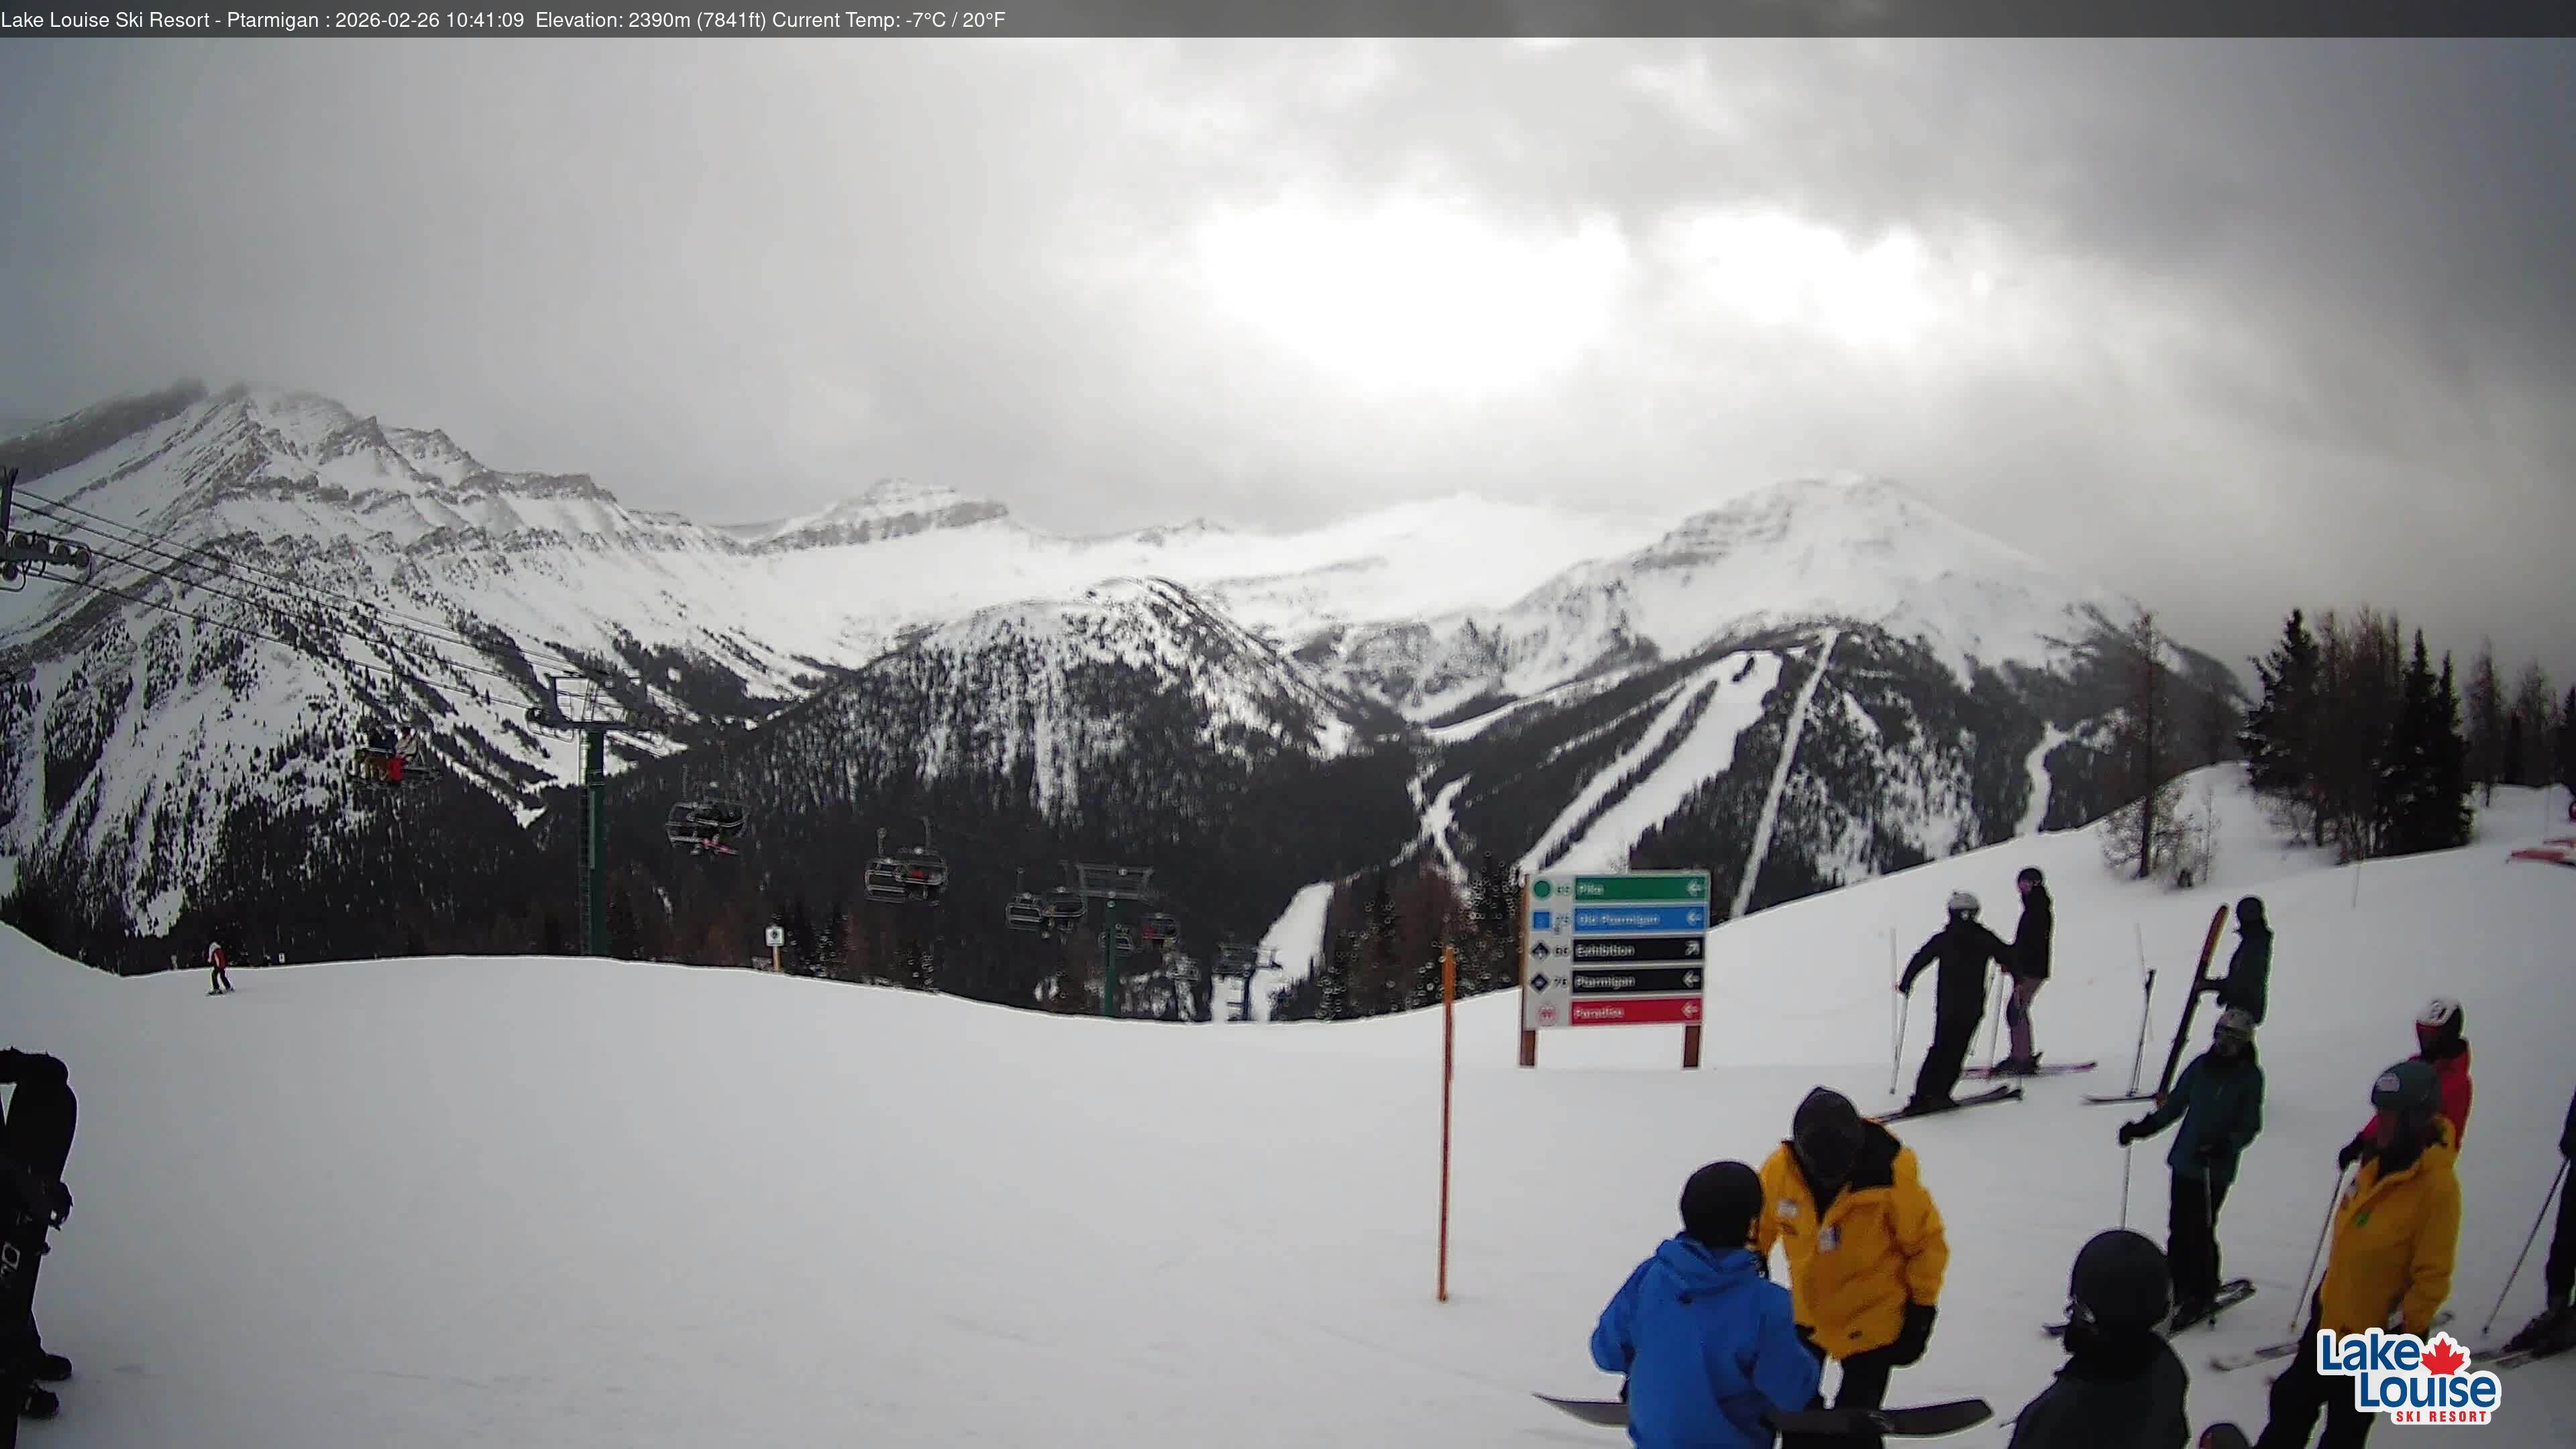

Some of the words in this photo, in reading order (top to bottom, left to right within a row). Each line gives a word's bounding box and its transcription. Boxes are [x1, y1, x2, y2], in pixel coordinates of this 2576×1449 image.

[1576, 945, 1635, 957] Exhibition
[1575, 976, 1635, 990] Ptarmigan
[1574, 1007, 1624, 1020] Paradise
